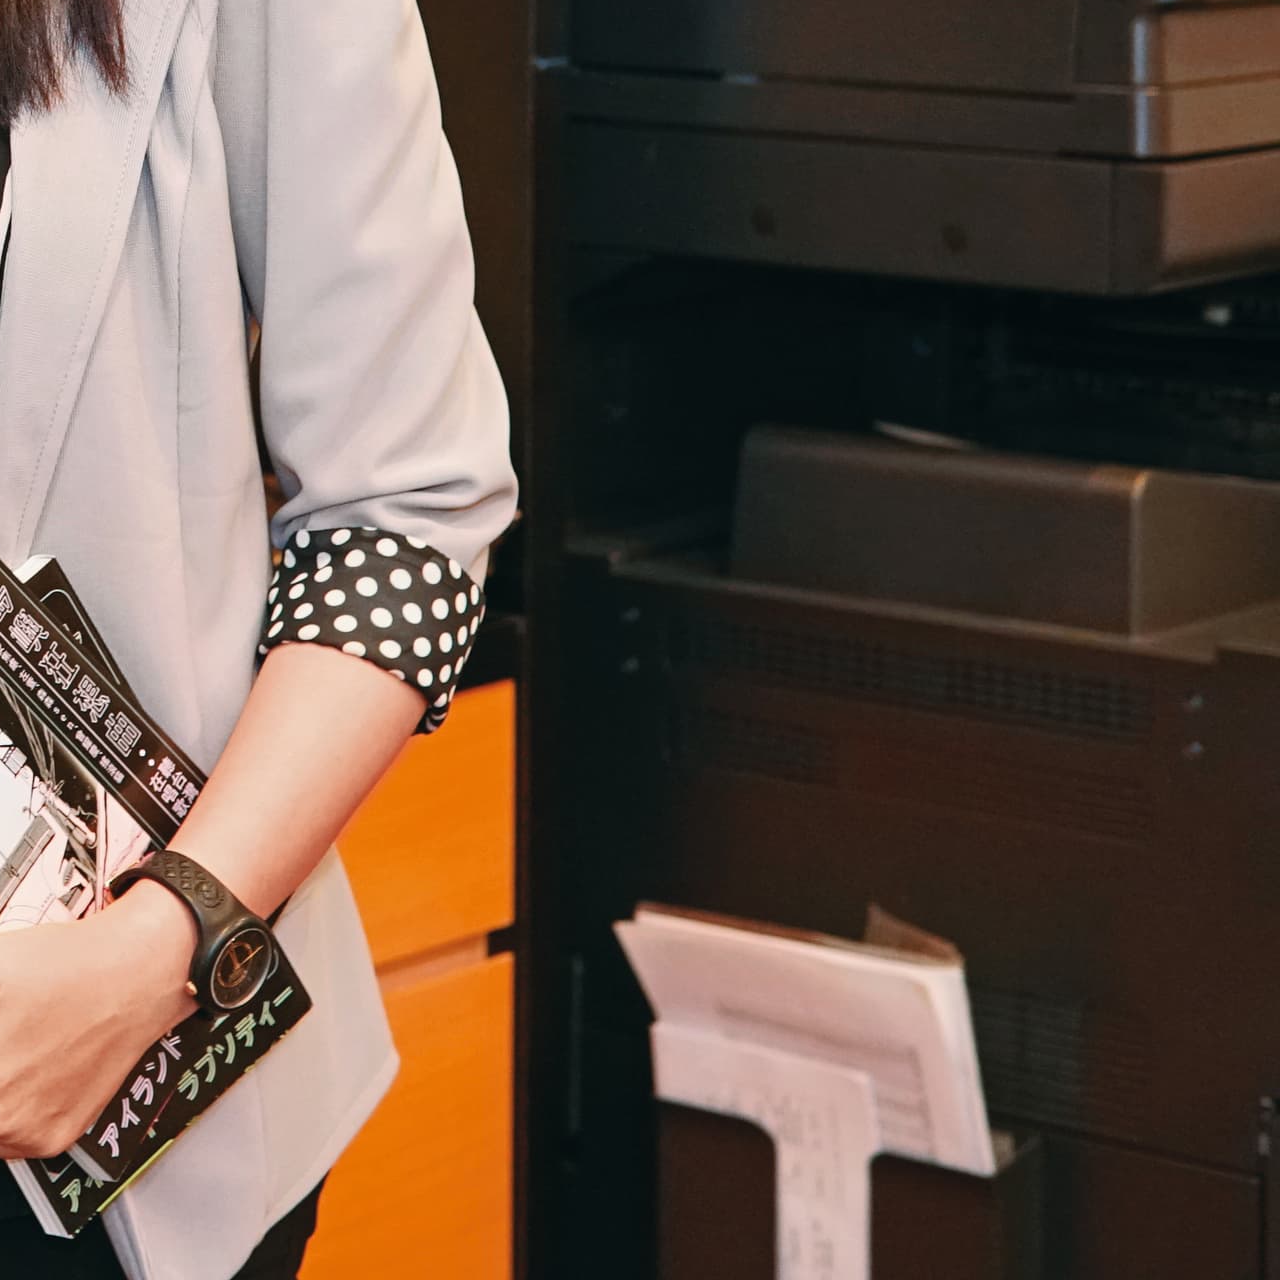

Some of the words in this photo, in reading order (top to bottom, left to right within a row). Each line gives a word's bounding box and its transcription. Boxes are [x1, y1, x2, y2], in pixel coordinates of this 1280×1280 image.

[177, 986, 294, 1101] ラプソディー
